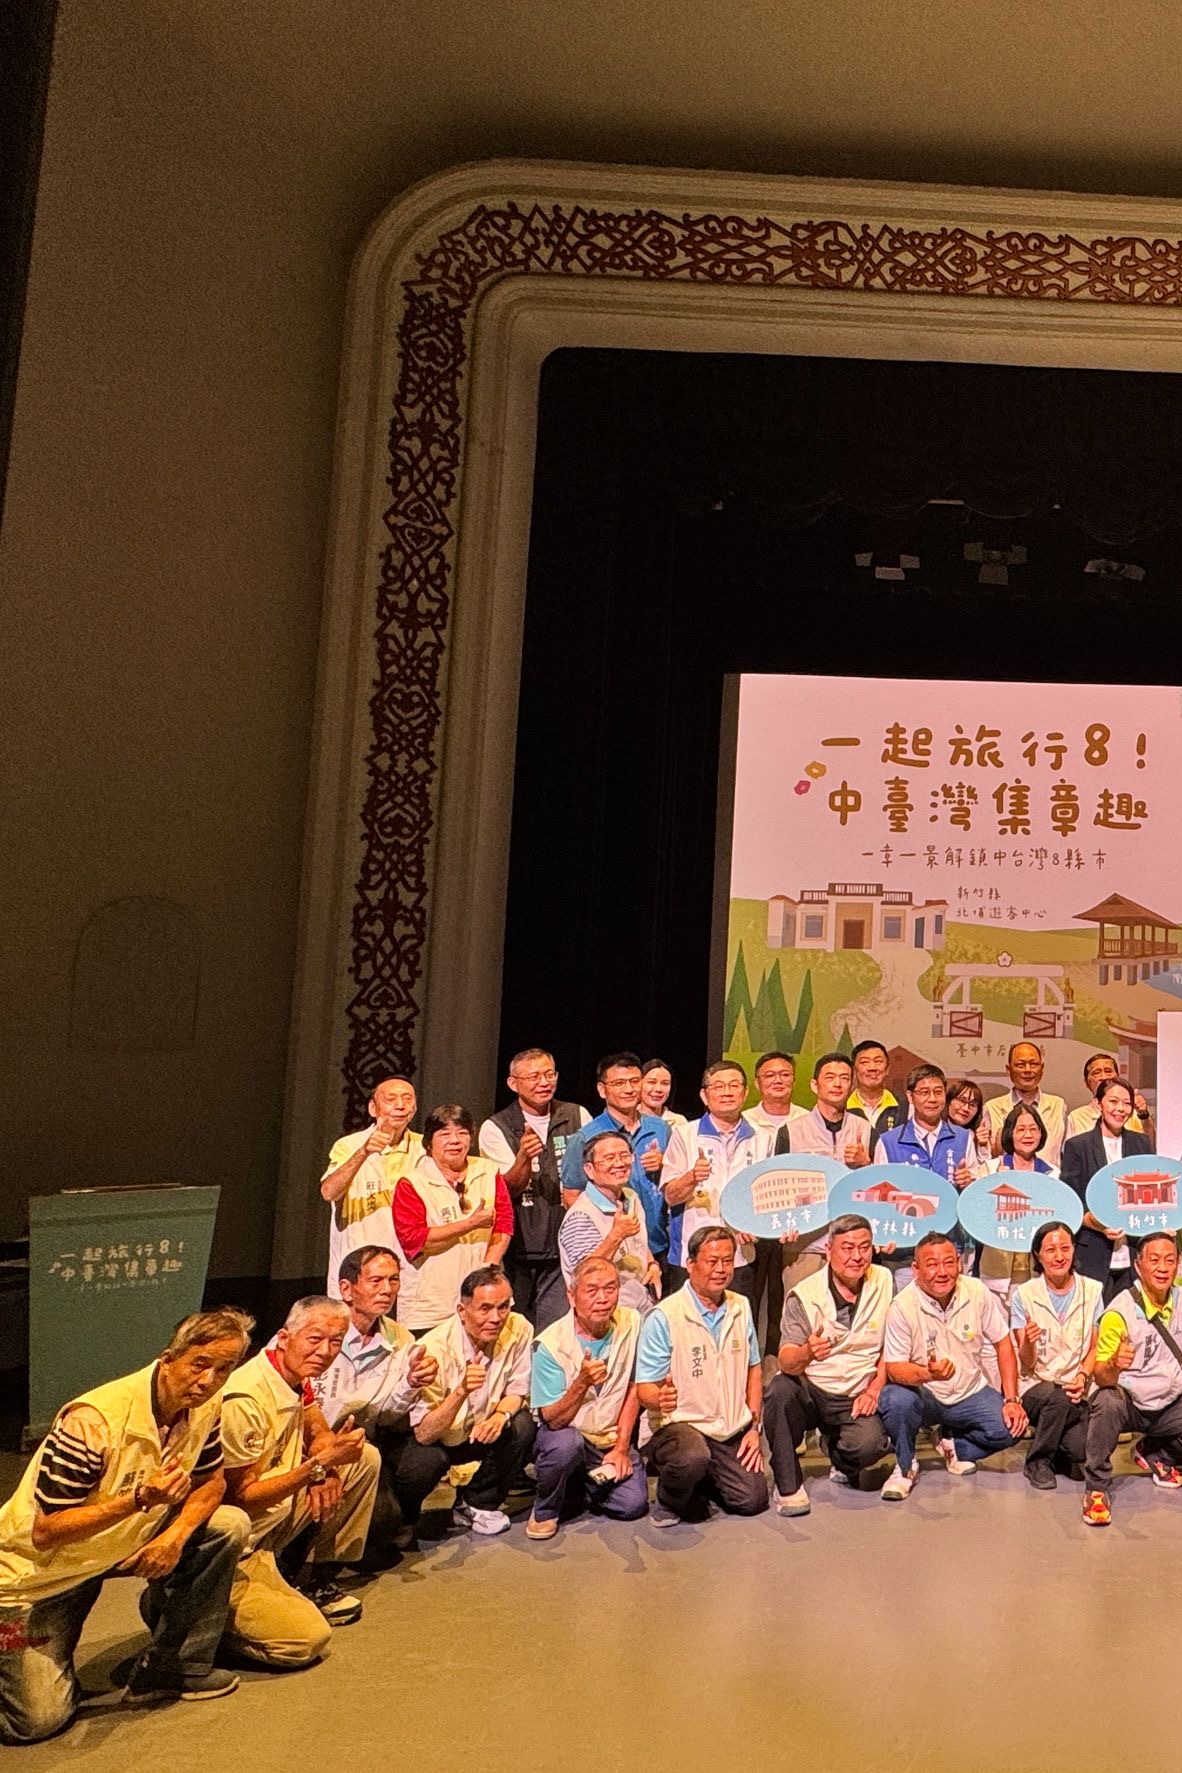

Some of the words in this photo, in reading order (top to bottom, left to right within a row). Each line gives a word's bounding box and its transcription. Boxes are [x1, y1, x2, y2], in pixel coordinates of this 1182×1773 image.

[828, 775, 1149, 837] 中臺灣集章趣
[770, 1209, 812, 1230] 嘉義市
[1128, 1213, 1169, 1230] 新竹市
